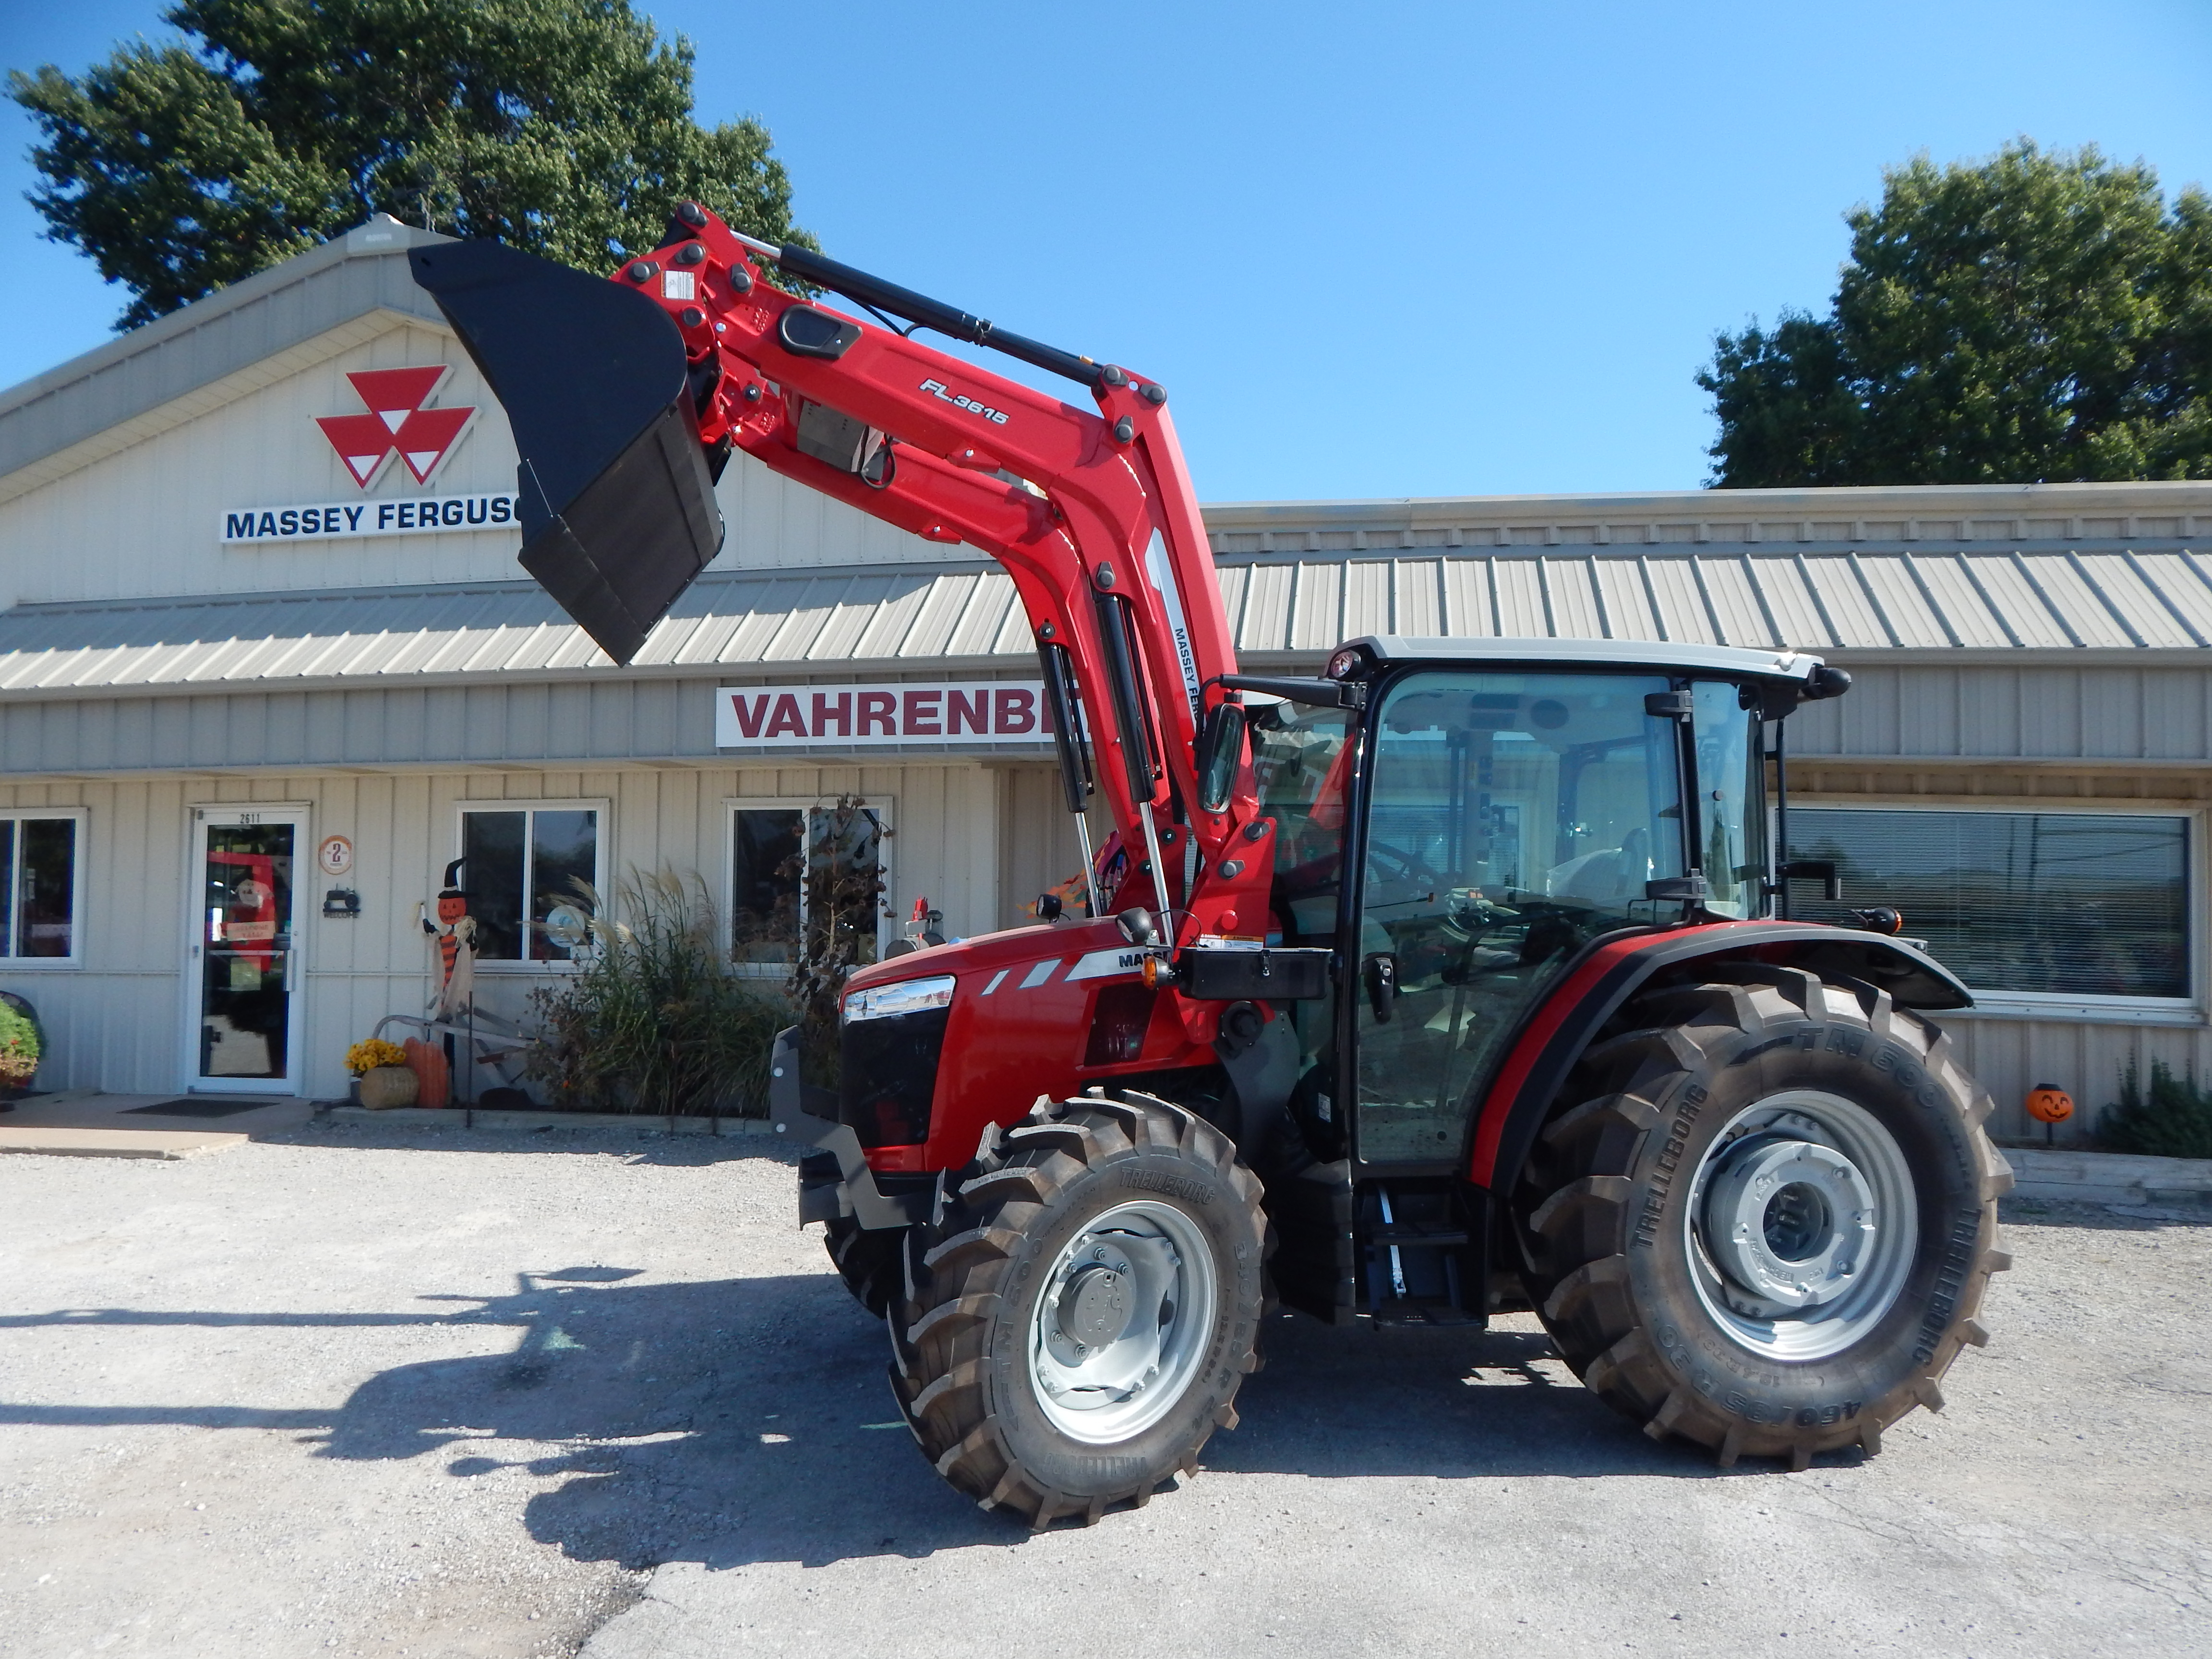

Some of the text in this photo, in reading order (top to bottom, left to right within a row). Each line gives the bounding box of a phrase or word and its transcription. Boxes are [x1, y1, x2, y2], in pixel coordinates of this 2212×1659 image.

[919, 378, 1010, 424] FL.3615
[227, 506, 363, 538] MASSEY
[1176, 628, 1195, 682] MASSEY
[240, 814, 260, 824] 2611
[332, 843, 340, 863] 2
[1798, 1027, 1942, 1107] TM 600
[1120, 1166, 1216, 1205] TRELLEBORG
[1630, 1082, 1708, 1249] TRELLEBORG
[1912, 1208, 1982, 1367] TRELLEBORG
[1657, 1324, 1693, 1371] 30
[1722, 1390, 1862, 1429] 460/85
[1042, 1453, 1149, 1477] TRELLEBORG
